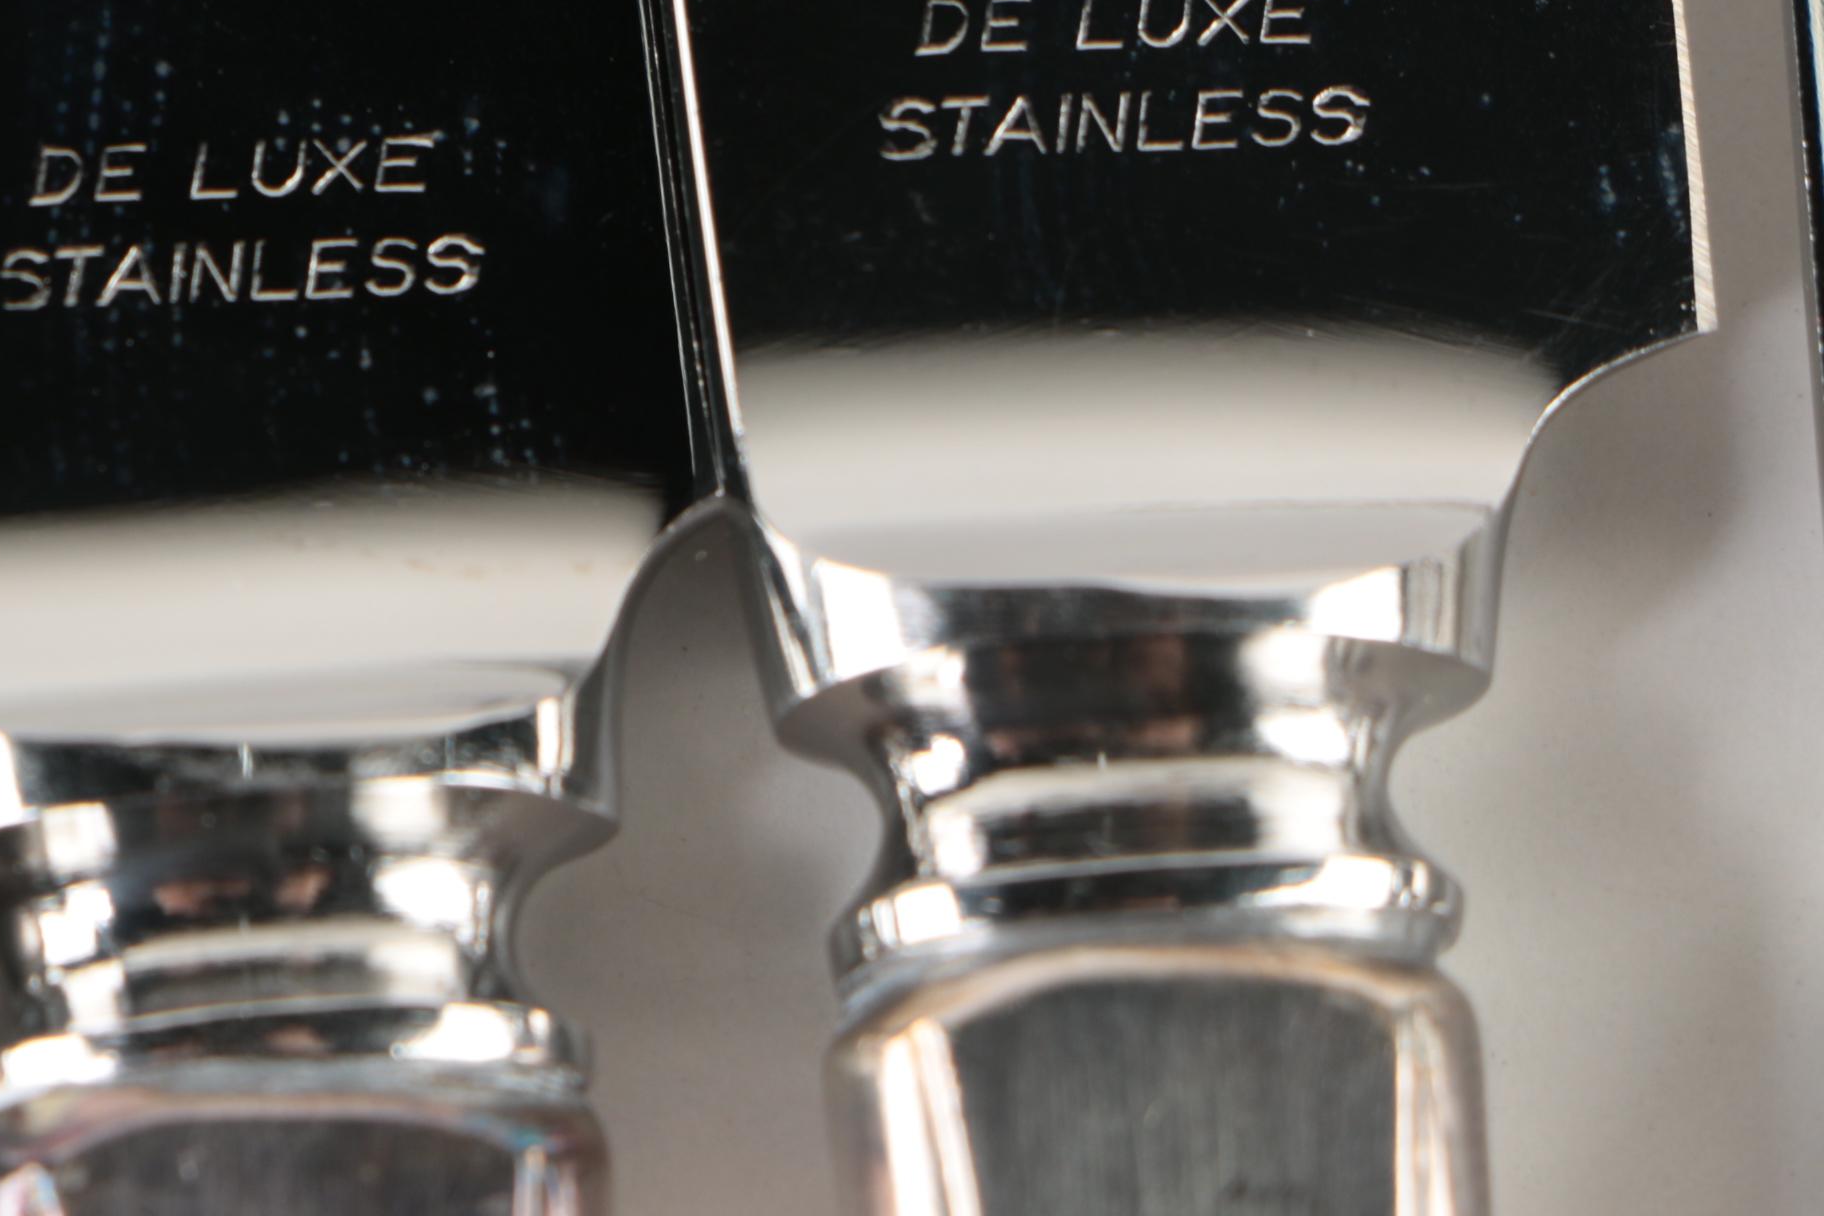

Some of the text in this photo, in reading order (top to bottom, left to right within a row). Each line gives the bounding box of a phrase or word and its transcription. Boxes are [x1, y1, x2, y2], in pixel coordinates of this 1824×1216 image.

[878, 85, 1372, 162] STAINLESS
[28, 135, 436, 207] DE LUXE
[0, 233, 486, 311] STAINLESS
